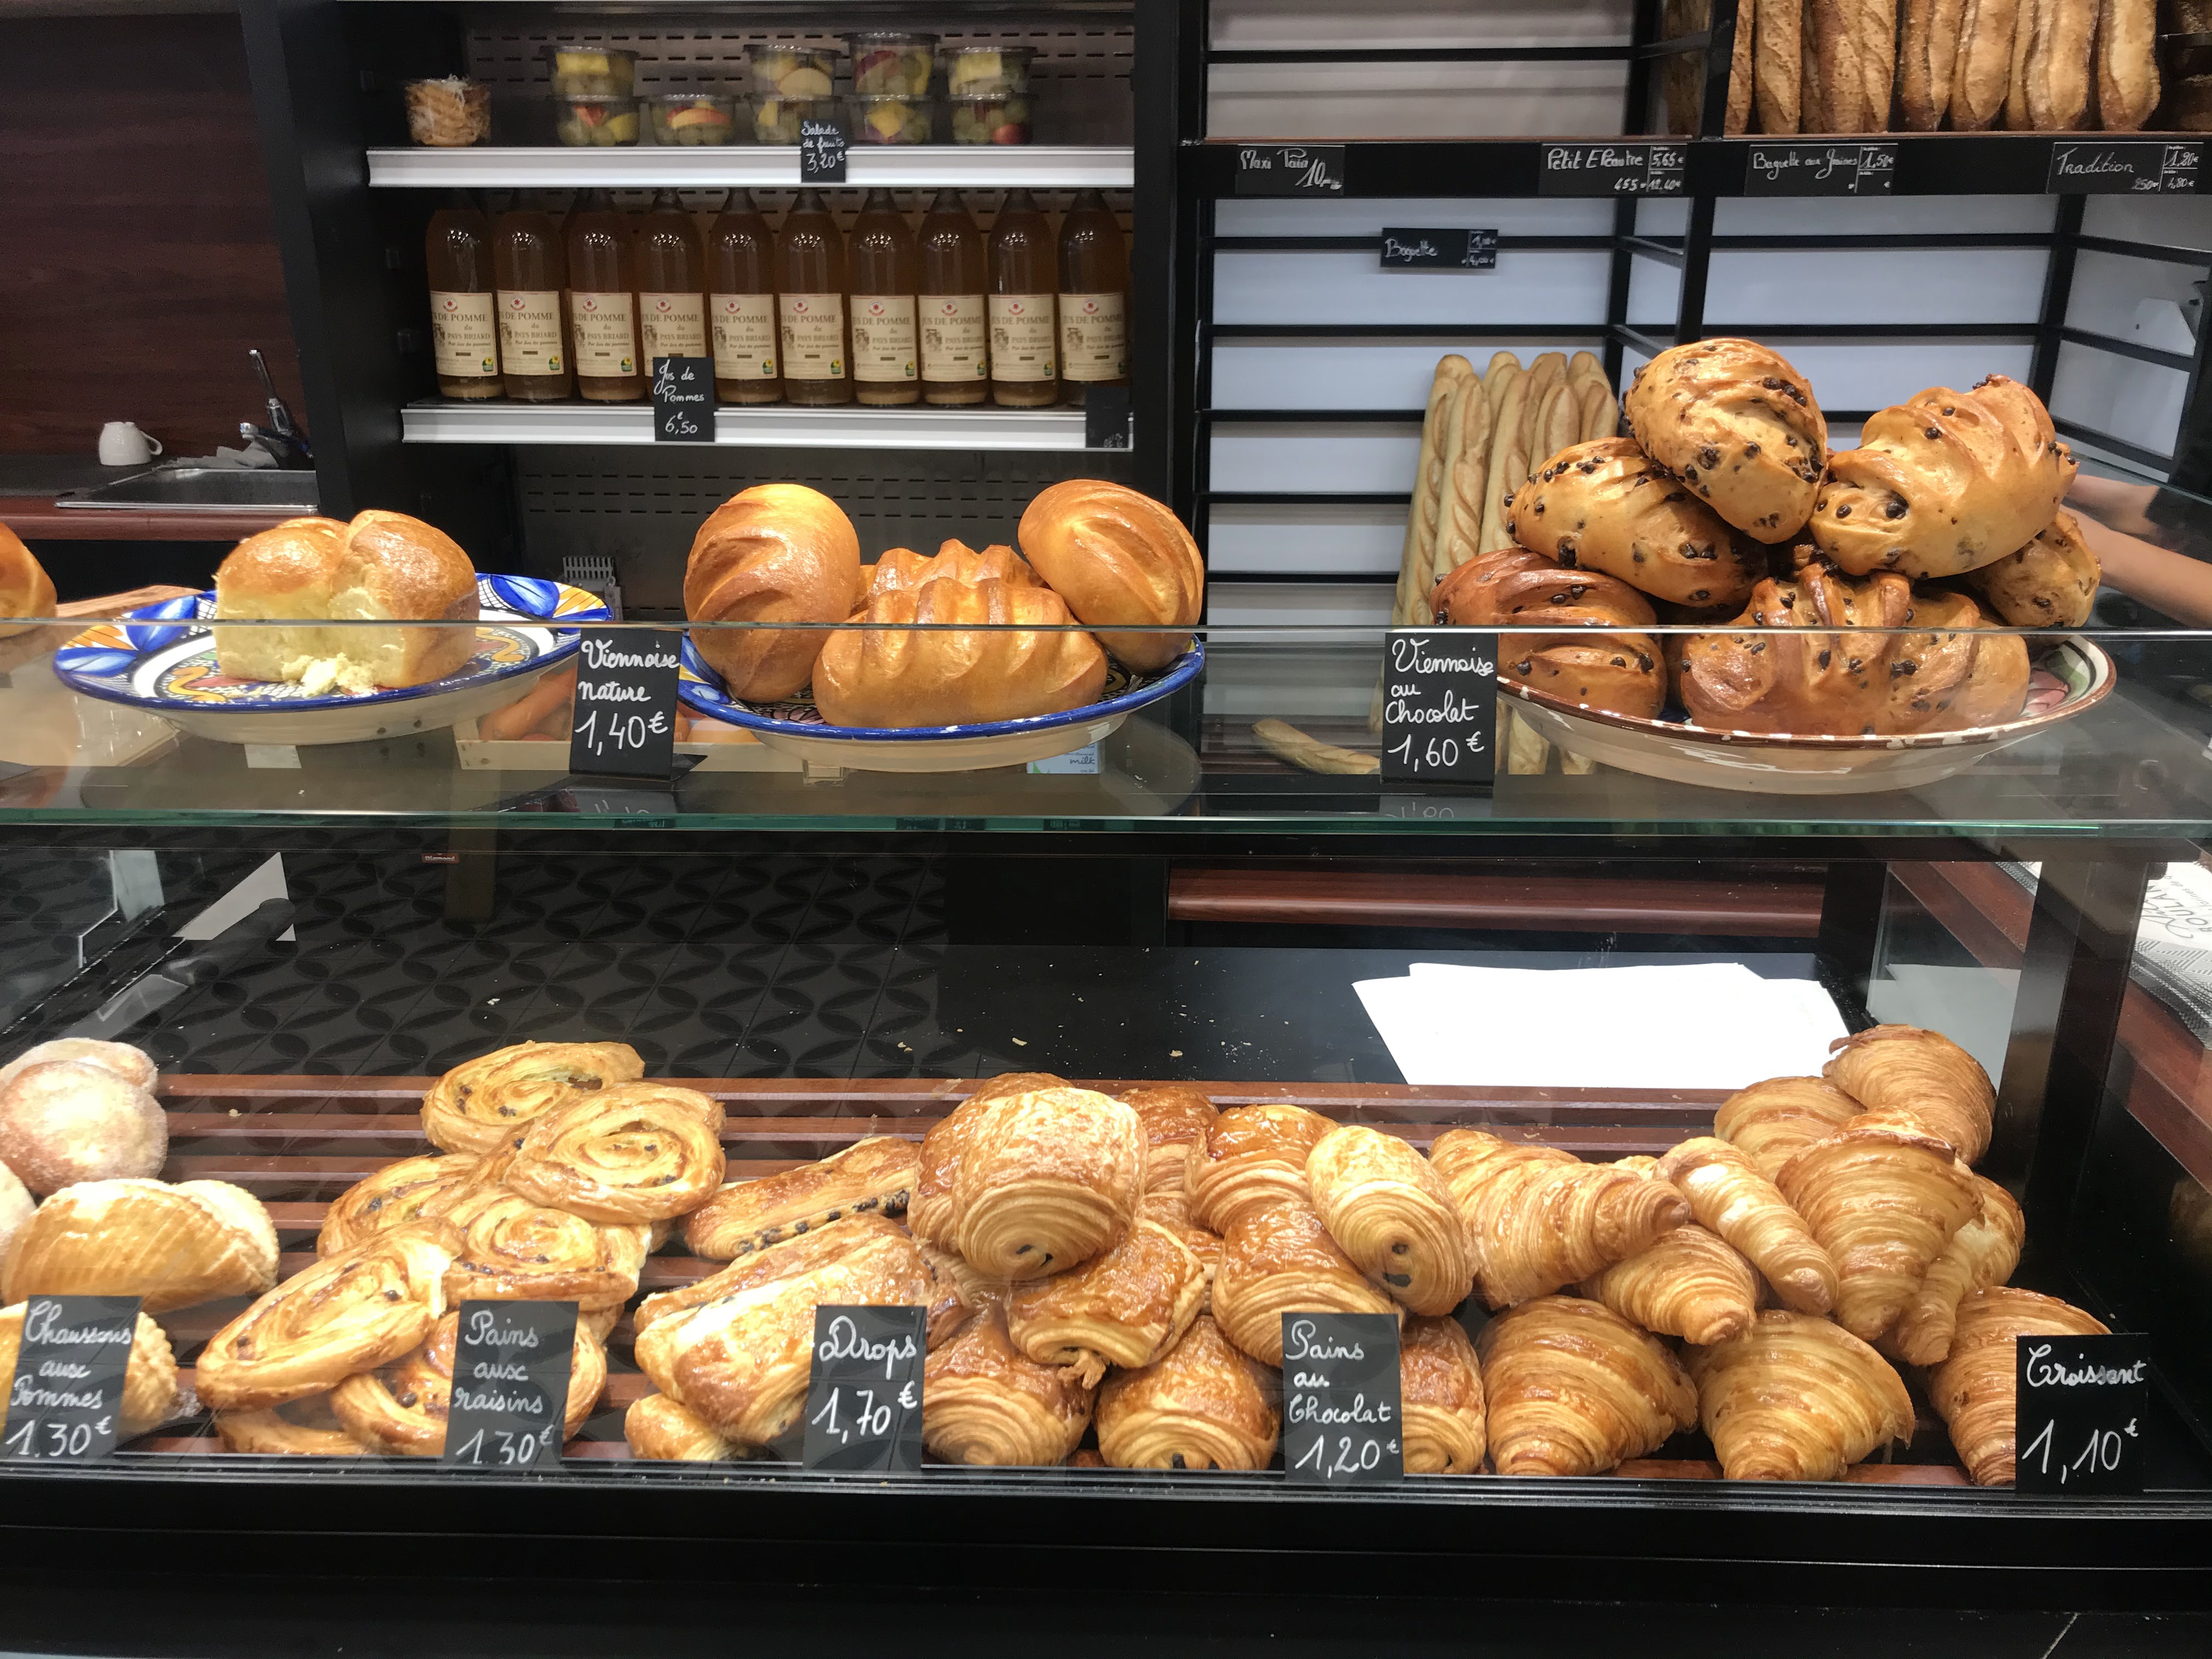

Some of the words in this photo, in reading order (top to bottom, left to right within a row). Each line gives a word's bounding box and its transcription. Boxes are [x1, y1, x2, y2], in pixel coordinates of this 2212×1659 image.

[1240, 149, 1271, 170] Maxi
[1277, 148, 1308, 168] Pain
[1547, 148, 1582, 170] Petit
[1753, 151, 1799, 180] Baguette
[2057, 146, 2134, 175] Tradition
[451, 314, 488, 322] POMME
[518, 312, 554, 320] POMME
[590, 313, 627, 321] POMME
[664, 314, 699, 322] POMME
[720, 315, 731, 324] DE
[733, 315, 768, 324] POMME
[788, 315, 799, 323] DE
[801, 314, 837, 324] POMME
[861, 317, 873, 325] DE
[877, 317, 911, 325] POMME
[654, 359, 675, 395] Jus
[681, 366, 695, 380] de
[662, 385, 705, 403] Pommes
[581, 639, 680, 669] Viennoise
[1392, 638, 1494, 676] Viennoise
[1391, 684, 1421, 698] au
[1385, 690, 1479, 724] Chocolat
[574, 710, 668, 756] 1,40€
[1070, 755, 1095, 764] milk
[1387, 731, 1485, 772] 1,60€
[25, 1301, 132, 1345] Chaussons
[465, 1310, 539, 1348] Pains
[819, 1316, 917, 1380] Drops
[1285, 1319, 1364, 1360] Pains
[39, 1360, 92, 1379] aux
[473, 1362, 529, 1381] aux
[2027, 1344, 2147, 1387] Croissant
[10, 1374, 103, 1409] Pommes
[453, 1387, 543, 1414] raisins
[811, 1380, 918, 1444] 1,70€
[1289, 1393, 1392, 1424] Chocolat
[1295, 1435, 1400, 1480] 1,20€
[2022, 1418, 2139, 1484] 1,10€
